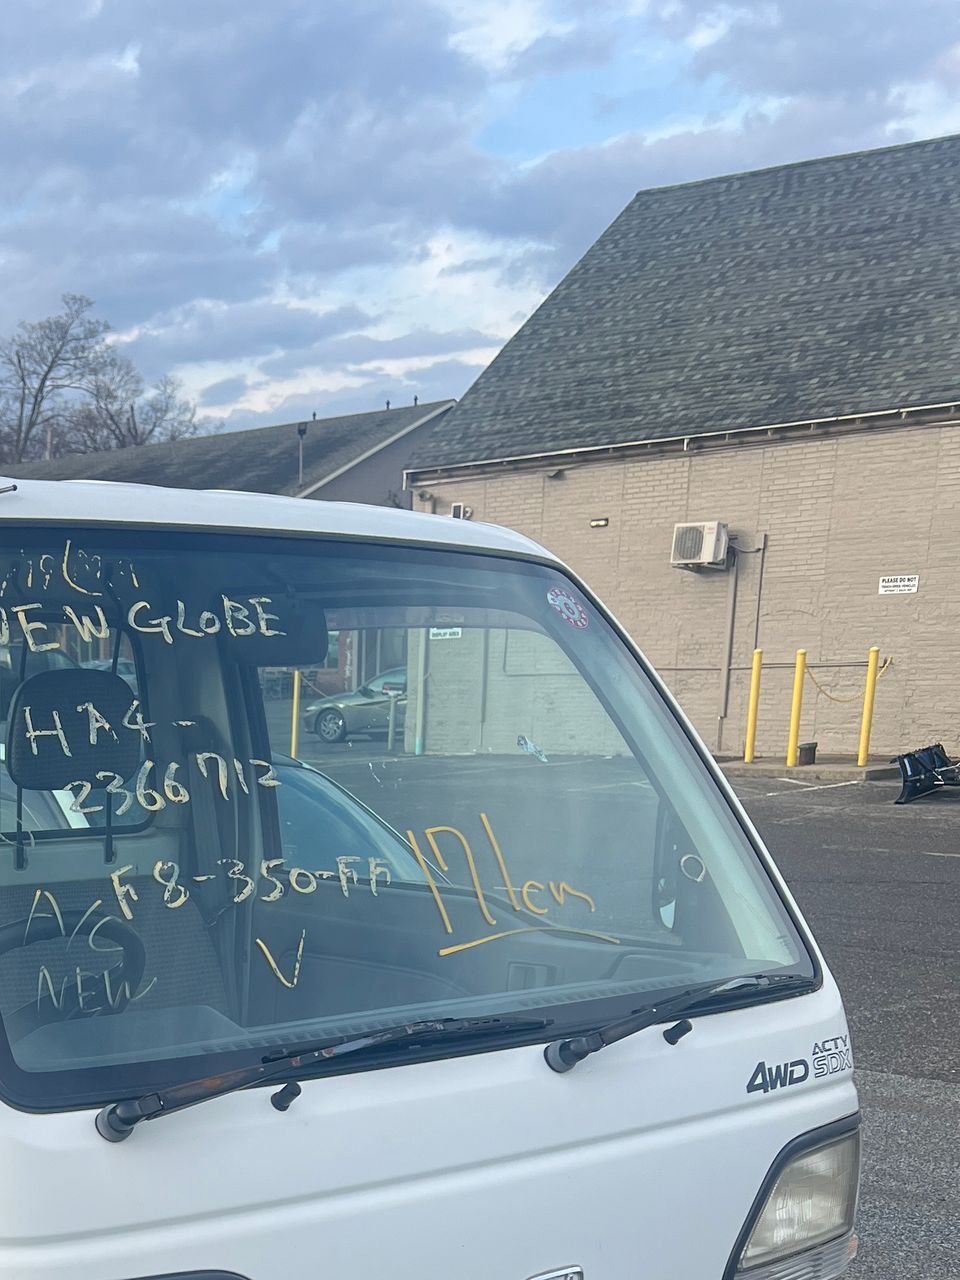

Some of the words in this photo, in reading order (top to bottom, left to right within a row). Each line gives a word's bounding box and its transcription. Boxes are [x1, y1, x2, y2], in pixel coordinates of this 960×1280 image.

[127, 594, 287, 645] GLOBE
[63, 752, 282, 817] 2366712
[24, 889, 125, 953] A/C
[37, 962, 158, 1015] NEW
[811, 1034, 848, 1056] ACTY
[746, 1058, 810, 1094] 4WD
[812, 1049, 852, 1079] SDX
